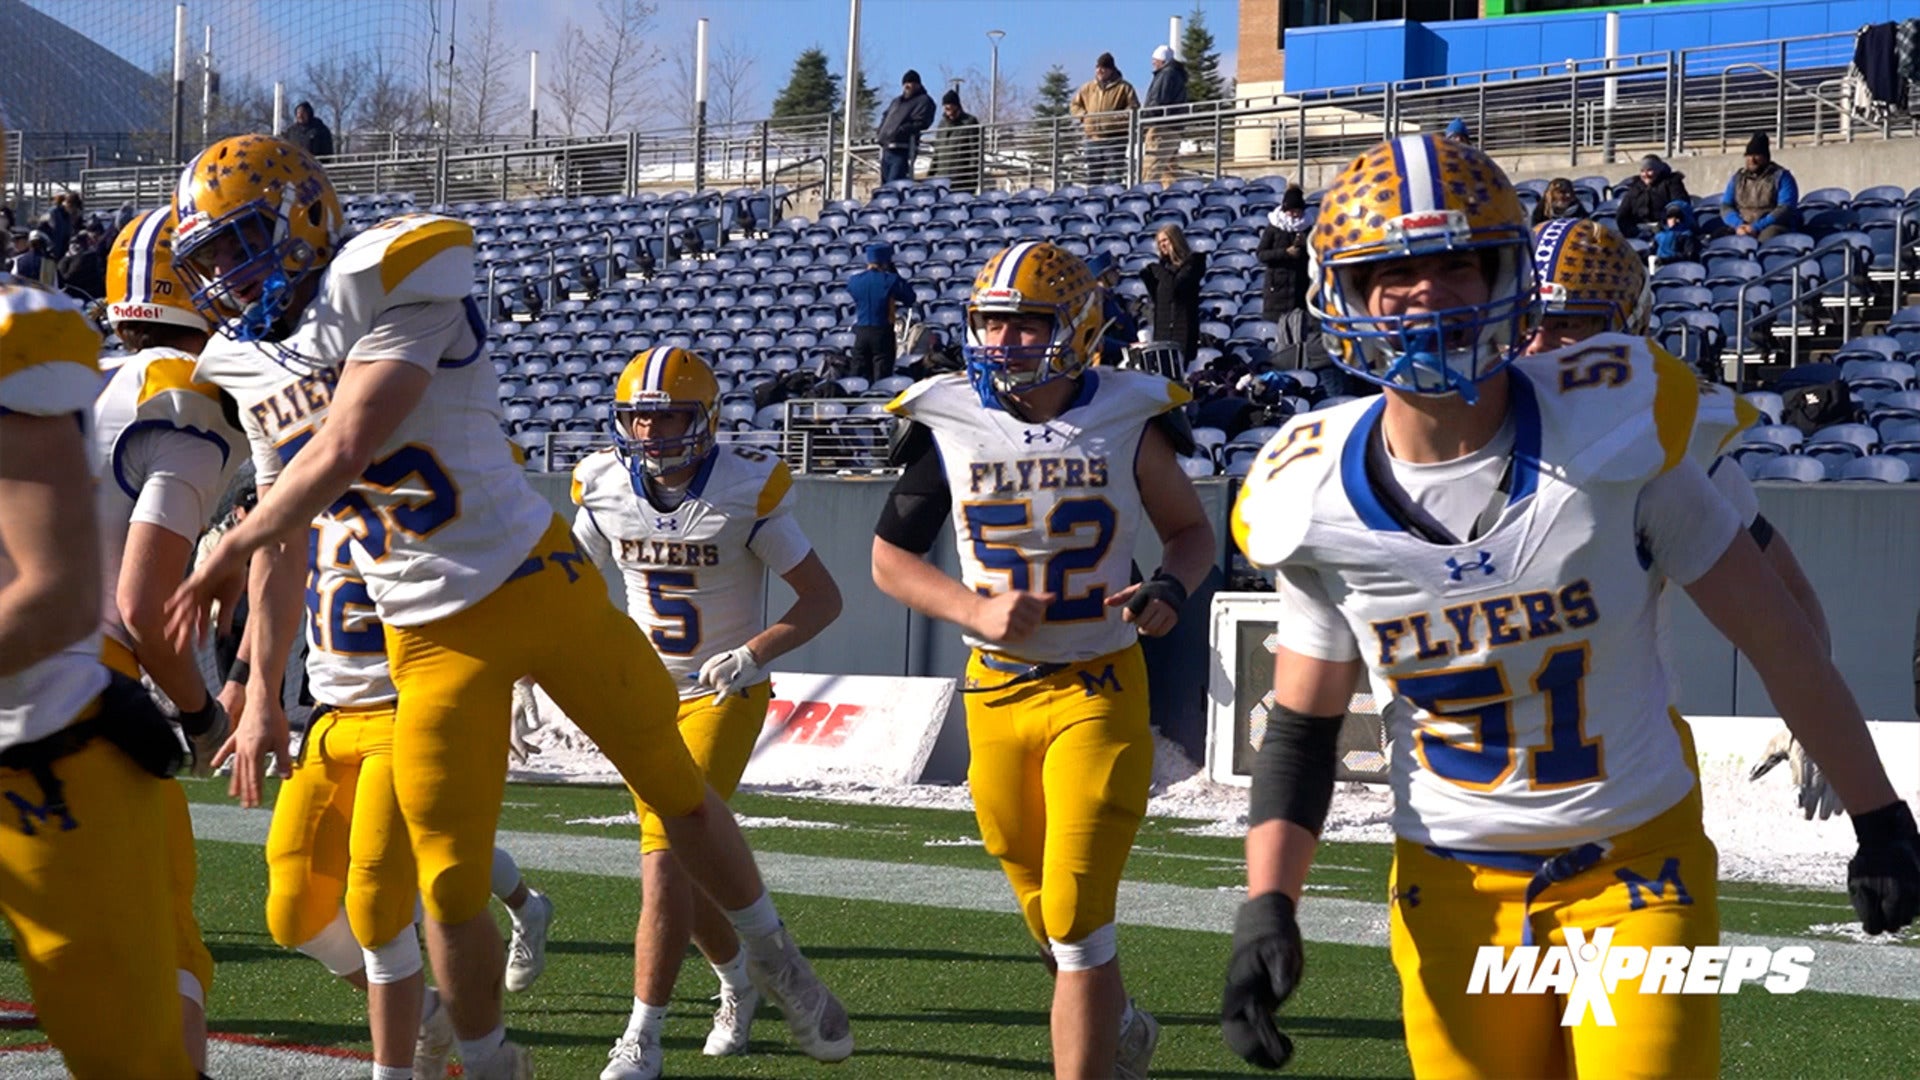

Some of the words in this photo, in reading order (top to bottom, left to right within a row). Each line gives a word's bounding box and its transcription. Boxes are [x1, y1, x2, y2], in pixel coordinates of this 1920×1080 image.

[153, 280, 173, 295] 70
[249, 360, 346, 437] FLYER
[1558, 344, 1633, 394] 51
[969, 457, 1109, 494] FLYERS
[1265, 418, 1326, 483] 51
[619, 538, 719, 567] FLYERS
[962, 495, 1119, 623] 52
[644, 570, 702, 657] 5
[1370, 578, 1600, 667] FLYERS
[1077, 664, 1123, 696] M
[1387, 639, 1608, 793] 51
[1614, 857, 1695, 910] M
